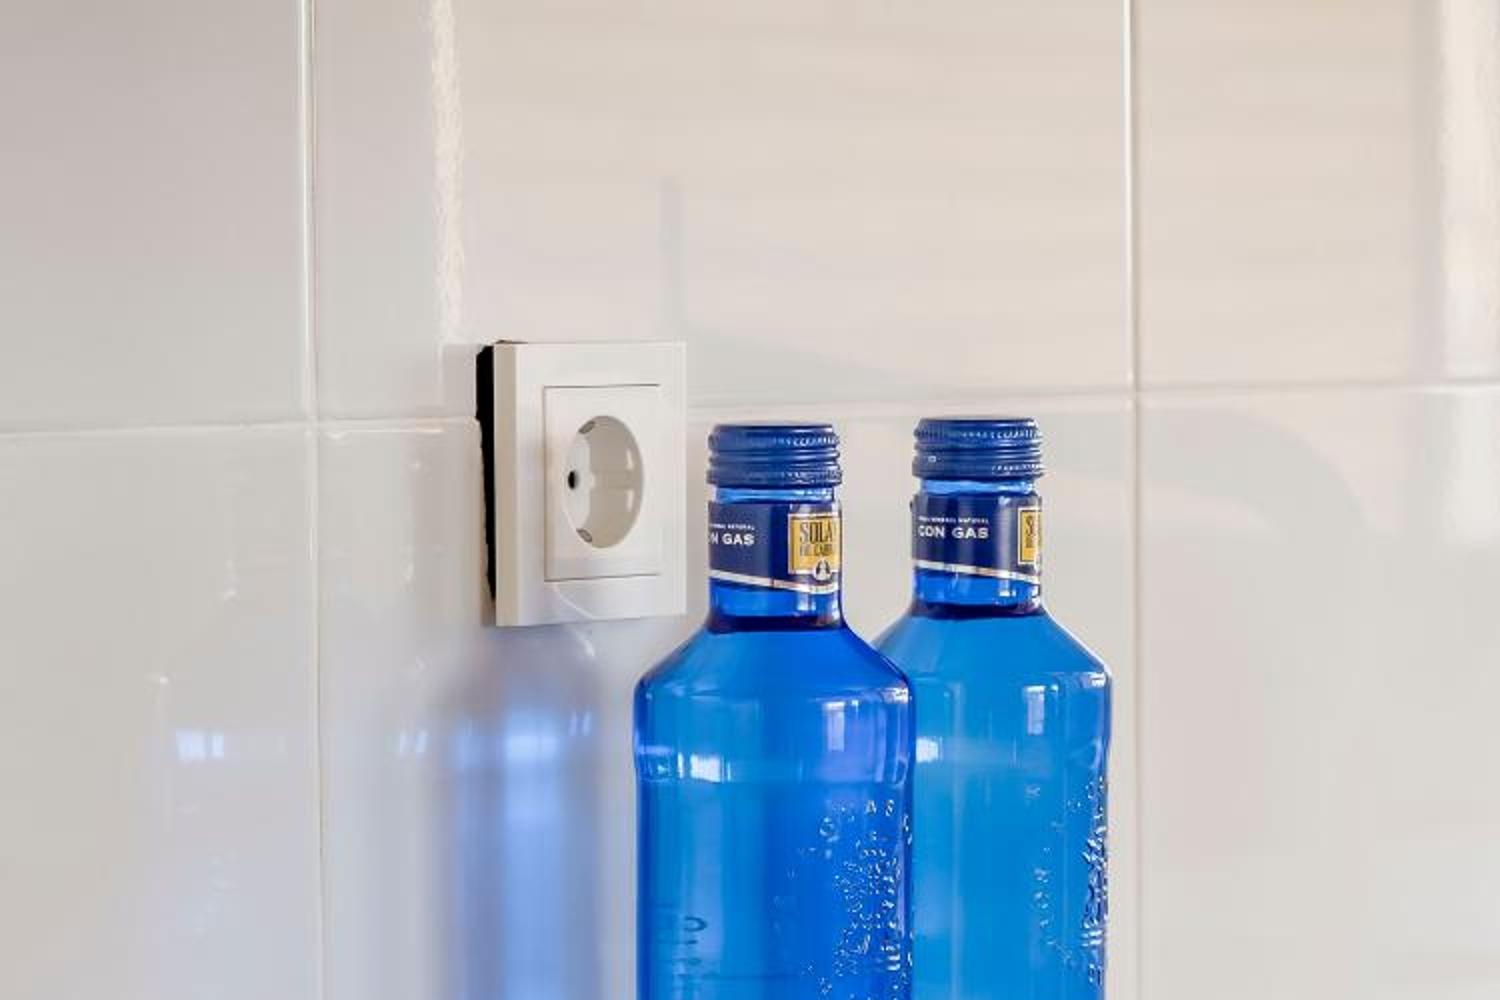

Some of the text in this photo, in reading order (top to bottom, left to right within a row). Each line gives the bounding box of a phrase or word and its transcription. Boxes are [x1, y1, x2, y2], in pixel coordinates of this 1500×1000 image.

[721, 532, 756, 547] GAS
[799, 520, 835, 544] SOLA
[918, 525, 990, 540] CON GAS
